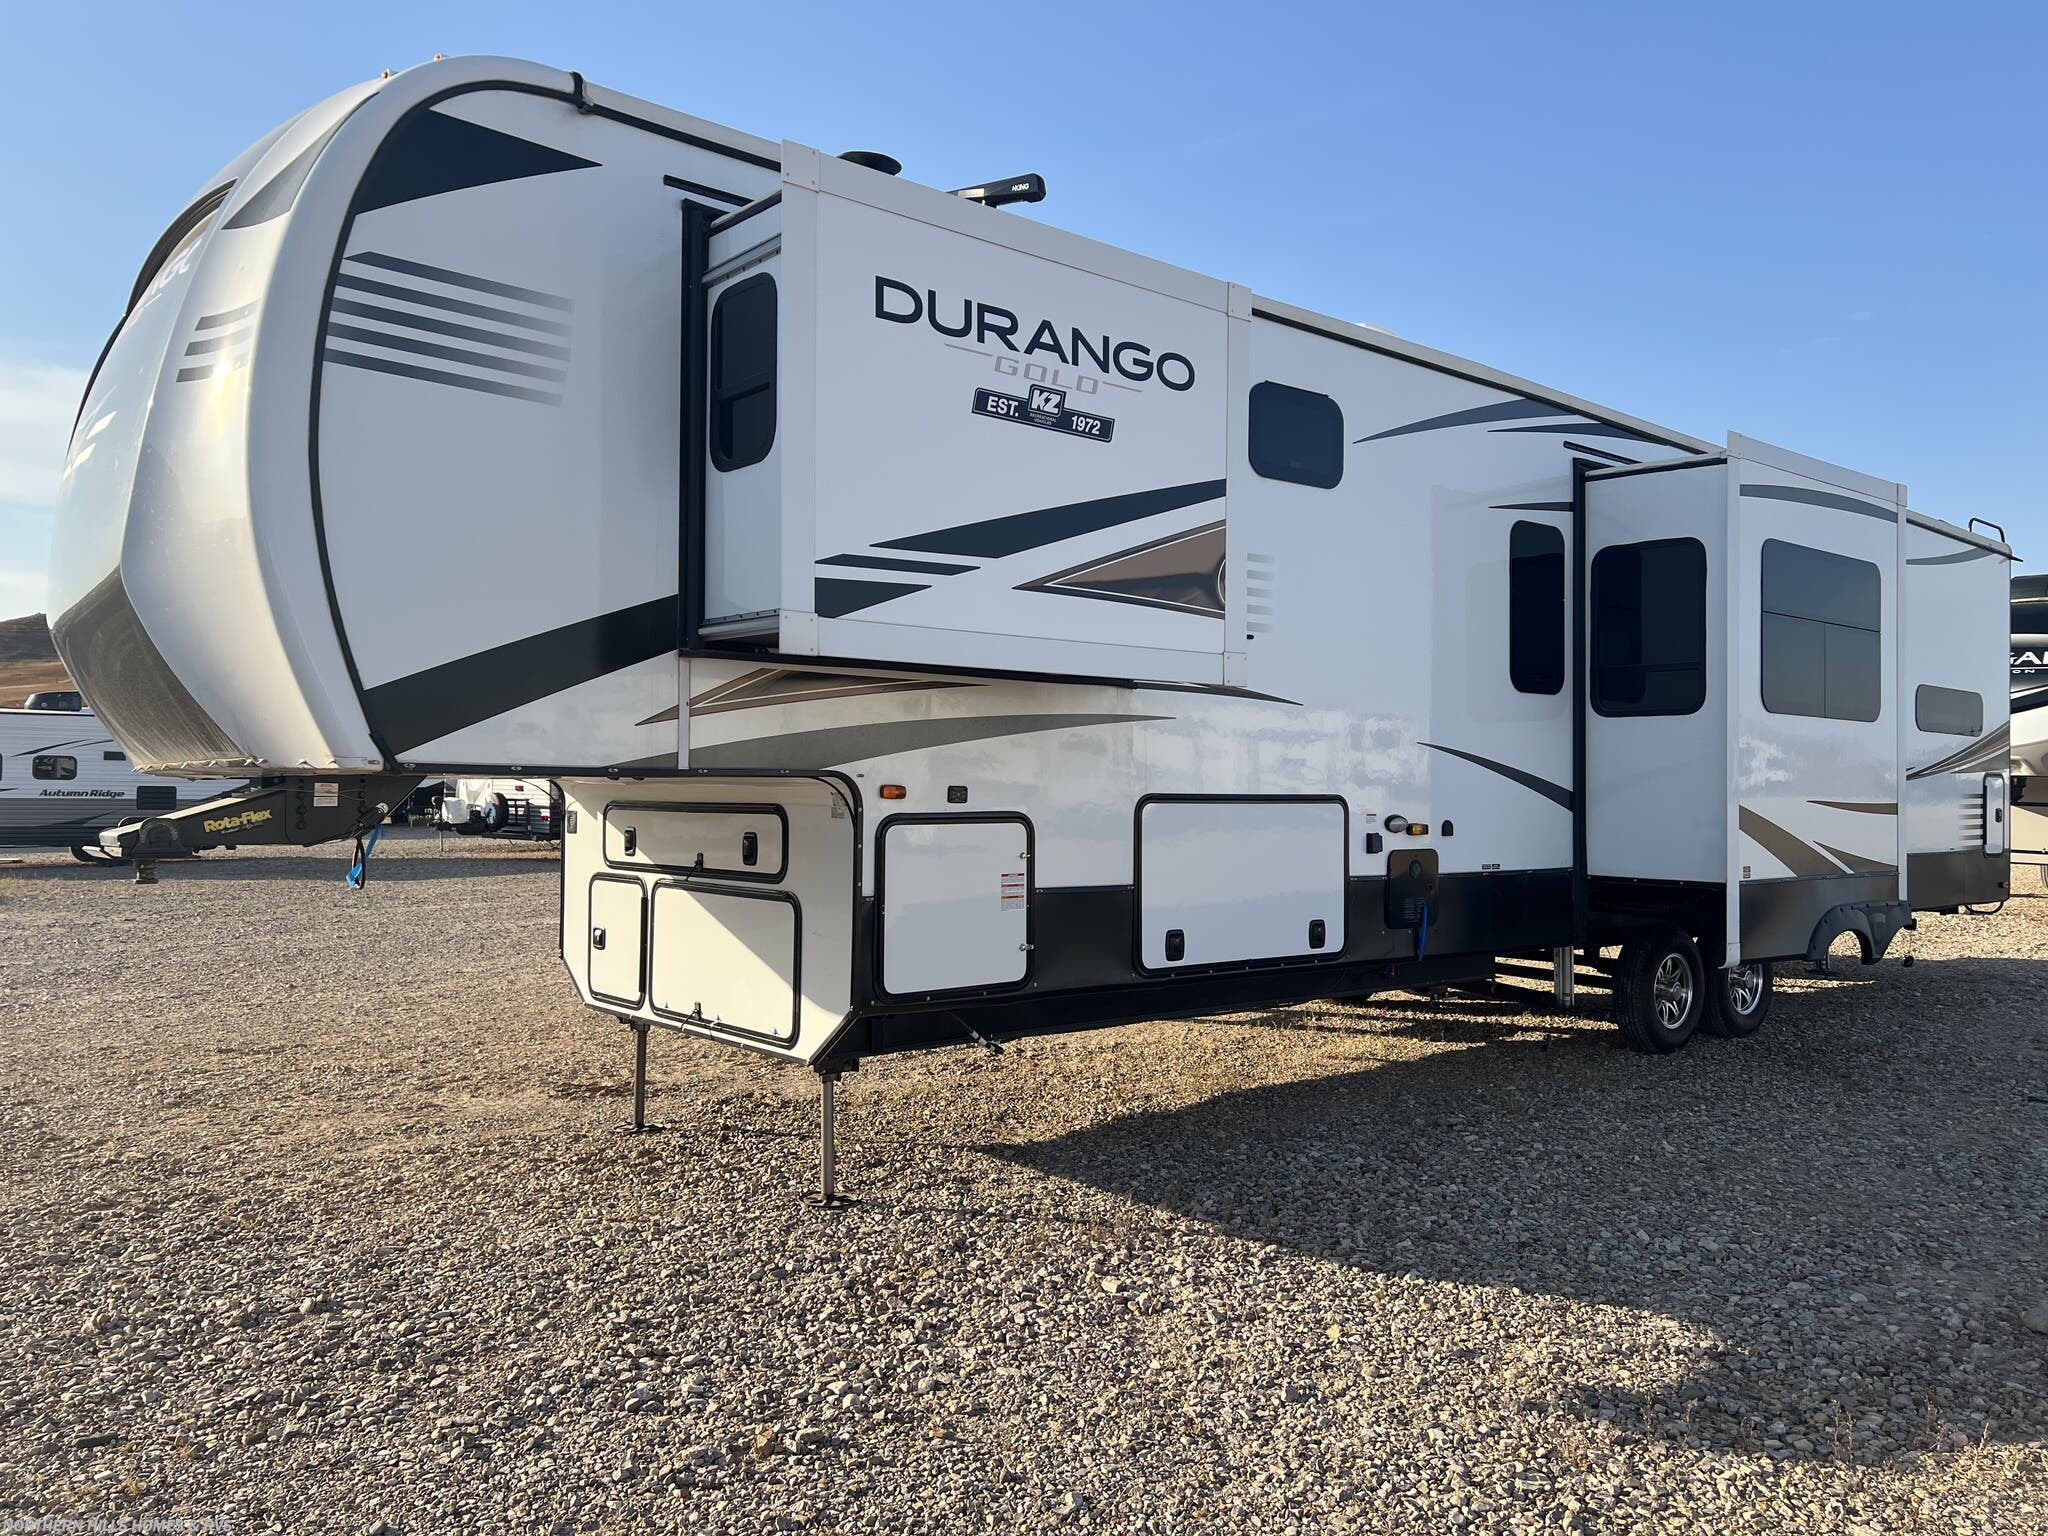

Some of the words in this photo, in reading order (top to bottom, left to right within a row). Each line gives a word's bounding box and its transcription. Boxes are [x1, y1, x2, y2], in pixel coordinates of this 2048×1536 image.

[874, 275, 1196, 392] DURANGO
[993, 355, 1099, 395] GOLD
[986, 395, 1019, 417] EST.
[1071, 415, 1101, 435] 1972
[1030, 389, 1061, 414] KZ
[40, 789, 88, 797] Autumn
[89, 789, 125, 798] Ridge
[203, 809, 273, 833] Rota-Flex
